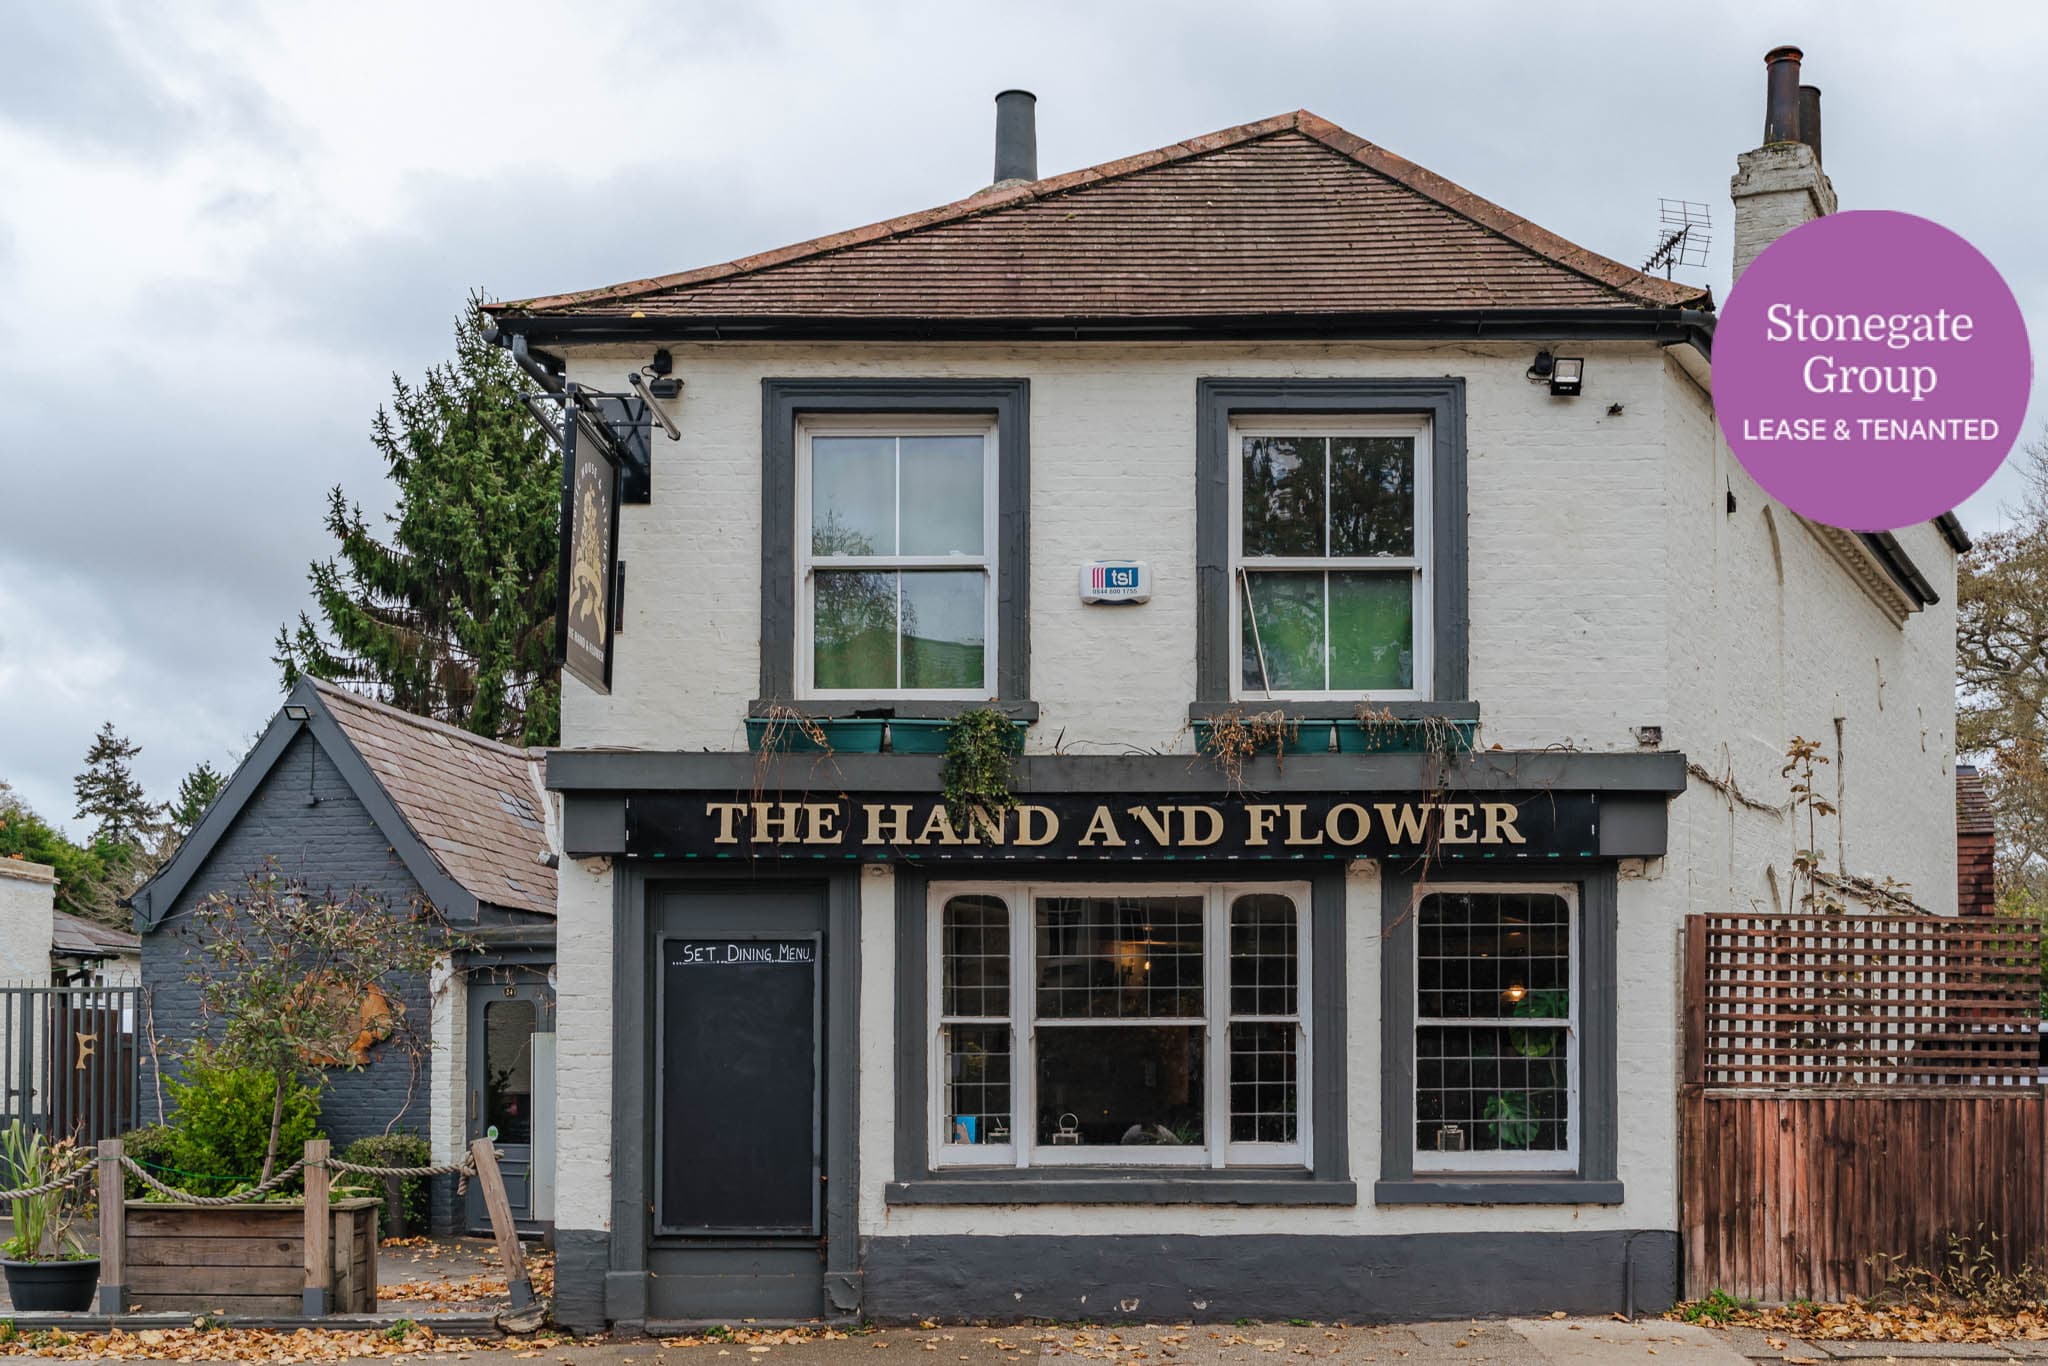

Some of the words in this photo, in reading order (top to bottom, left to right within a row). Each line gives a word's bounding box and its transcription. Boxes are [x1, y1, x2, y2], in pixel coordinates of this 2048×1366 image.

[706, 802, 843, 844] THE
[862, 804, 1059, 846] HAND
[1078, 805, 1224, 846] AND
[1244, 803, 1527, 846] FLOWER
[684, 944, 717, 963] SET
[727, 944, 772, 962] DINING
[778, 943, 811, 961] MENU
